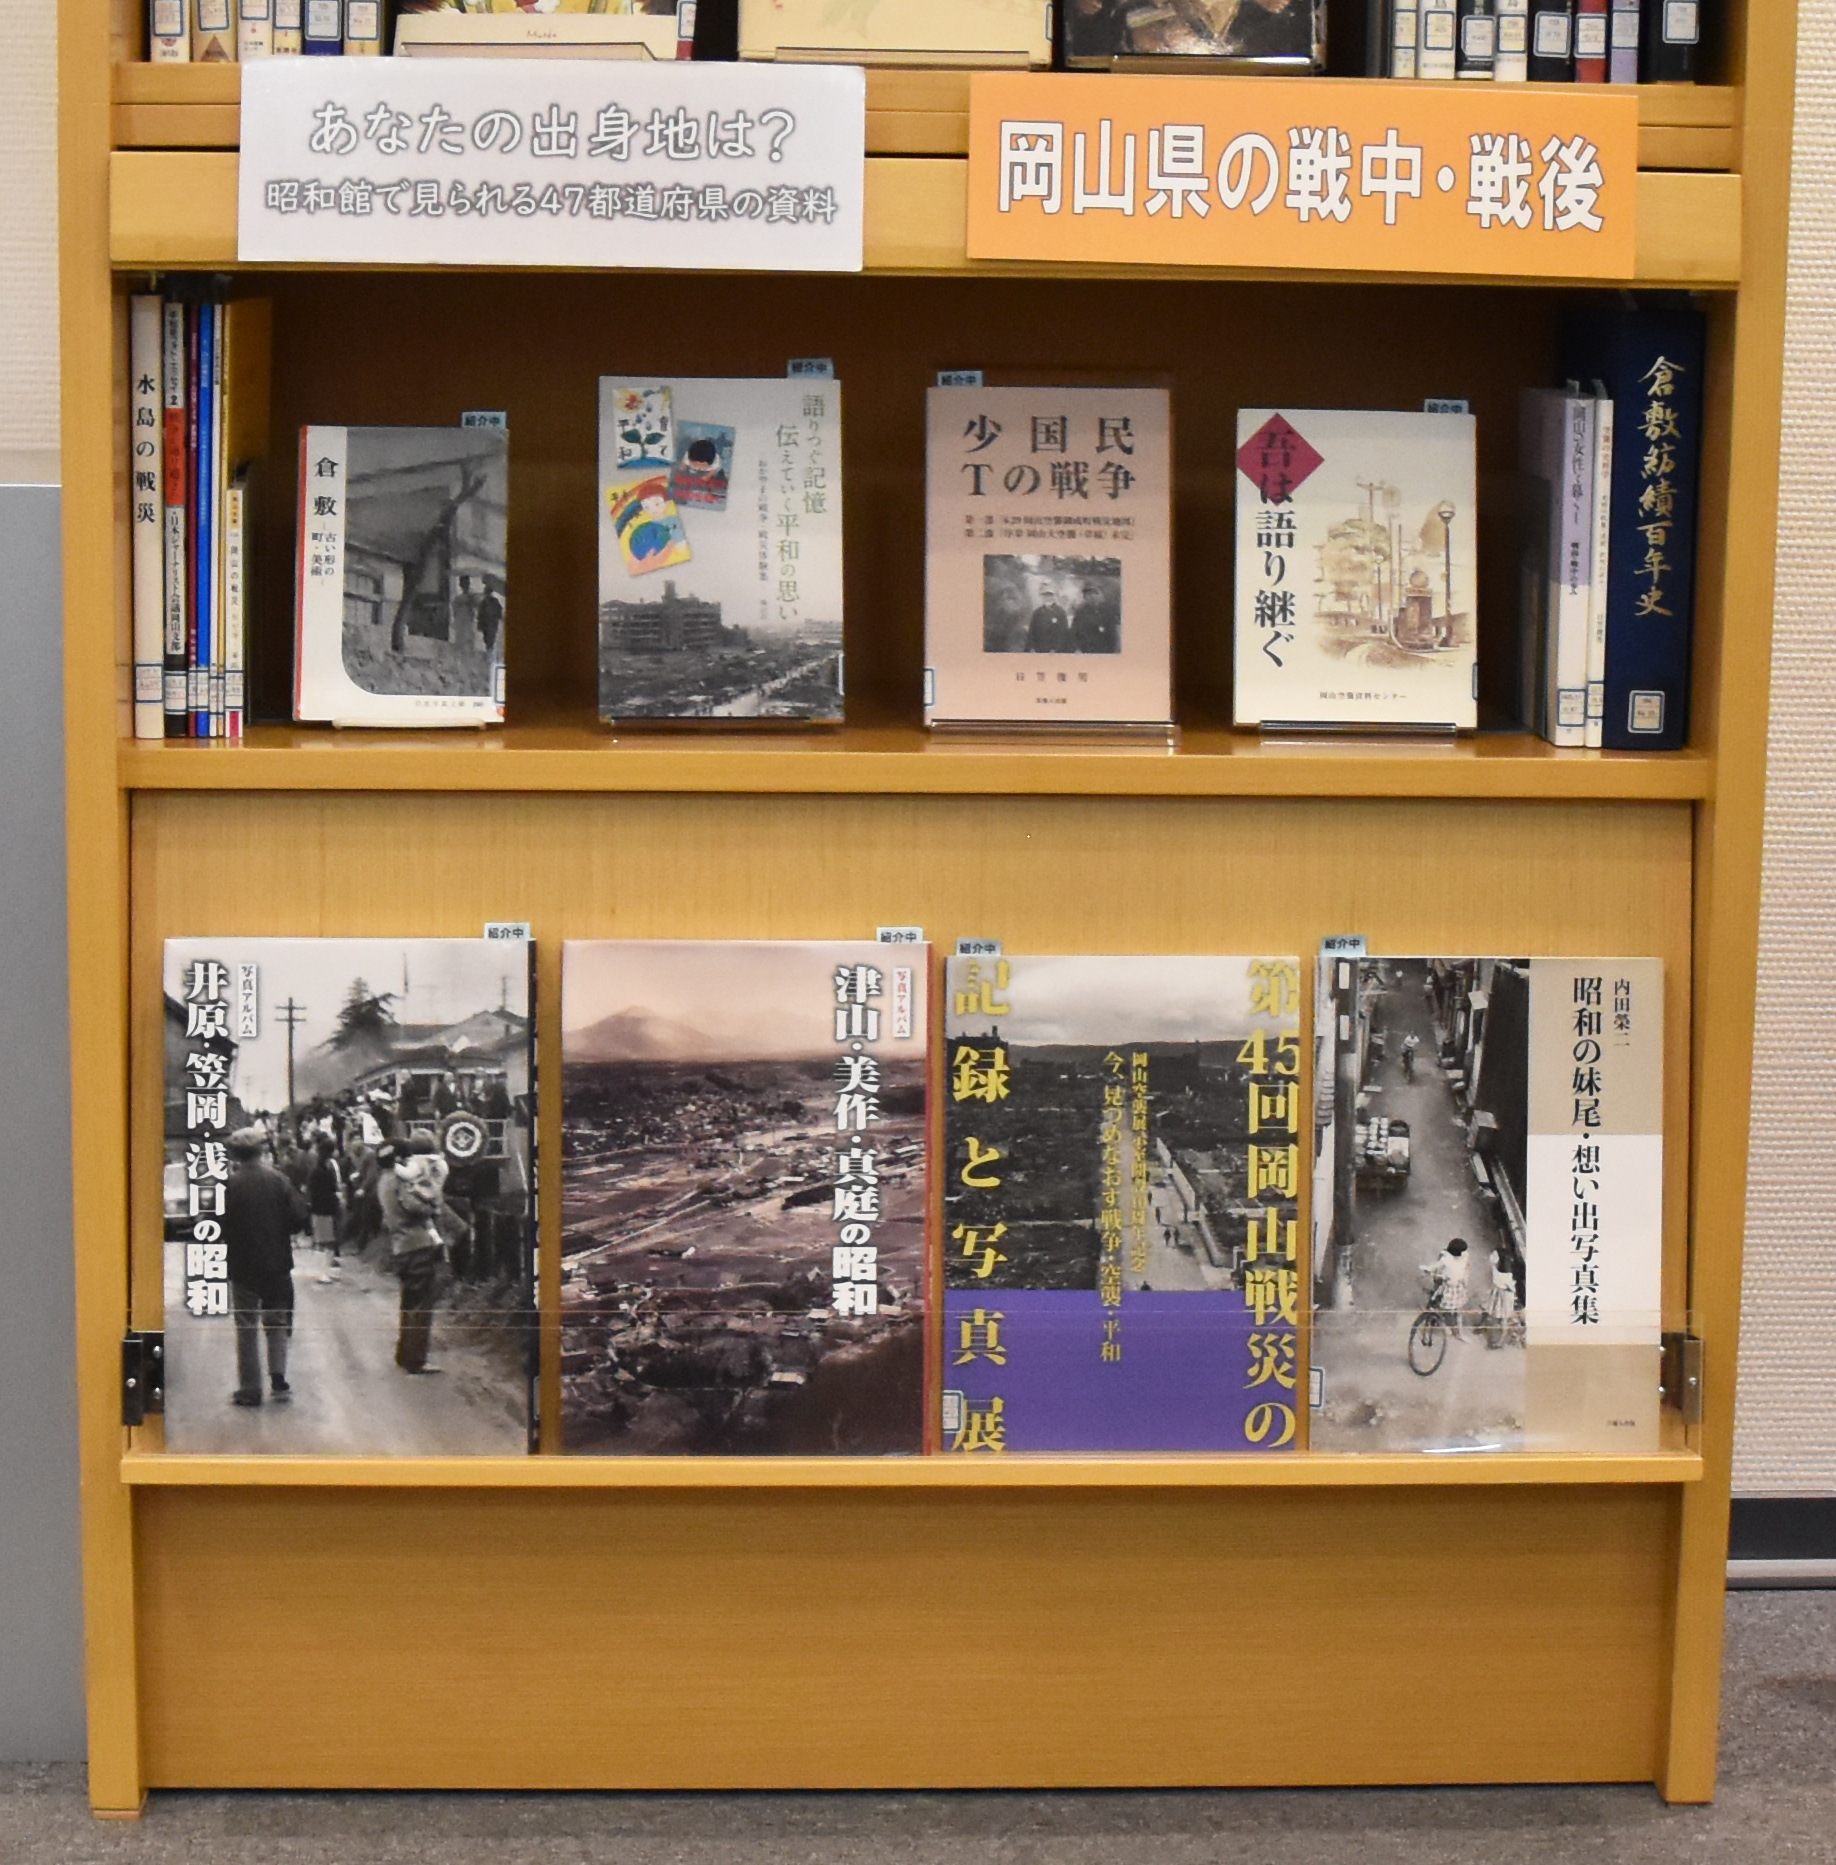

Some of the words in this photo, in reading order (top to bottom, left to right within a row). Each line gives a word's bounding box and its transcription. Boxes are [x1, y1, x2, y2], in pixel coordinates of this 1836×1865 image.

[310, 101, 796, 163] あなたの出身地は？
[266, 180, 838, 224] 昭和館で見られる47都道府県の資料
[998, 118, 1605, 232] 岡山県の戦中・戦後
[136, 373, 157, 524] 水島の戦災
[802, 394, 828, 515] 語りつぐ記憶
[963, 414, 1136, 456] 少国民
[313, 456, 339, 517] 倉敷
[961, 461, 1137, 500] Tの戦争
[1635, 355, 1685, 617] 倉敷紡績百年史
[324, 532, 337, 576] 古い形の
[775, 423, 800, 621] 伝えていく平和の思い
[1254, 430, 1298, 669] 吾は語り継ぐ
[487, 927, 524, 939] 紹介中
[880, 931, 918, 943] 紹介中
[958, 943, 997, 955] 紹介中
[1324, 938, 1361, 950] 紹介中
[240, 965, 256, 1036] 写真アルバム
[895, 968, 909, 1035] 写真アルバム
[1613, 978, 1632, 1047] 内田榮二
[185, 962, 229, 1316] 井原・笠岡・浅口の昭和
[831, 964, 882, 1317] 津山・美作・真庭の昭和
[1570, 975, 1604, 1326] 昭和の妹尾・想い出写真集
[951, 958, 1011, 1452] 記録と写真展
[1101, 1050, 1125, 1363] 今、見つめなおす戦争・空襲・平和
[1236, 958, 1300, 1449] 第45回岡山戦災の
